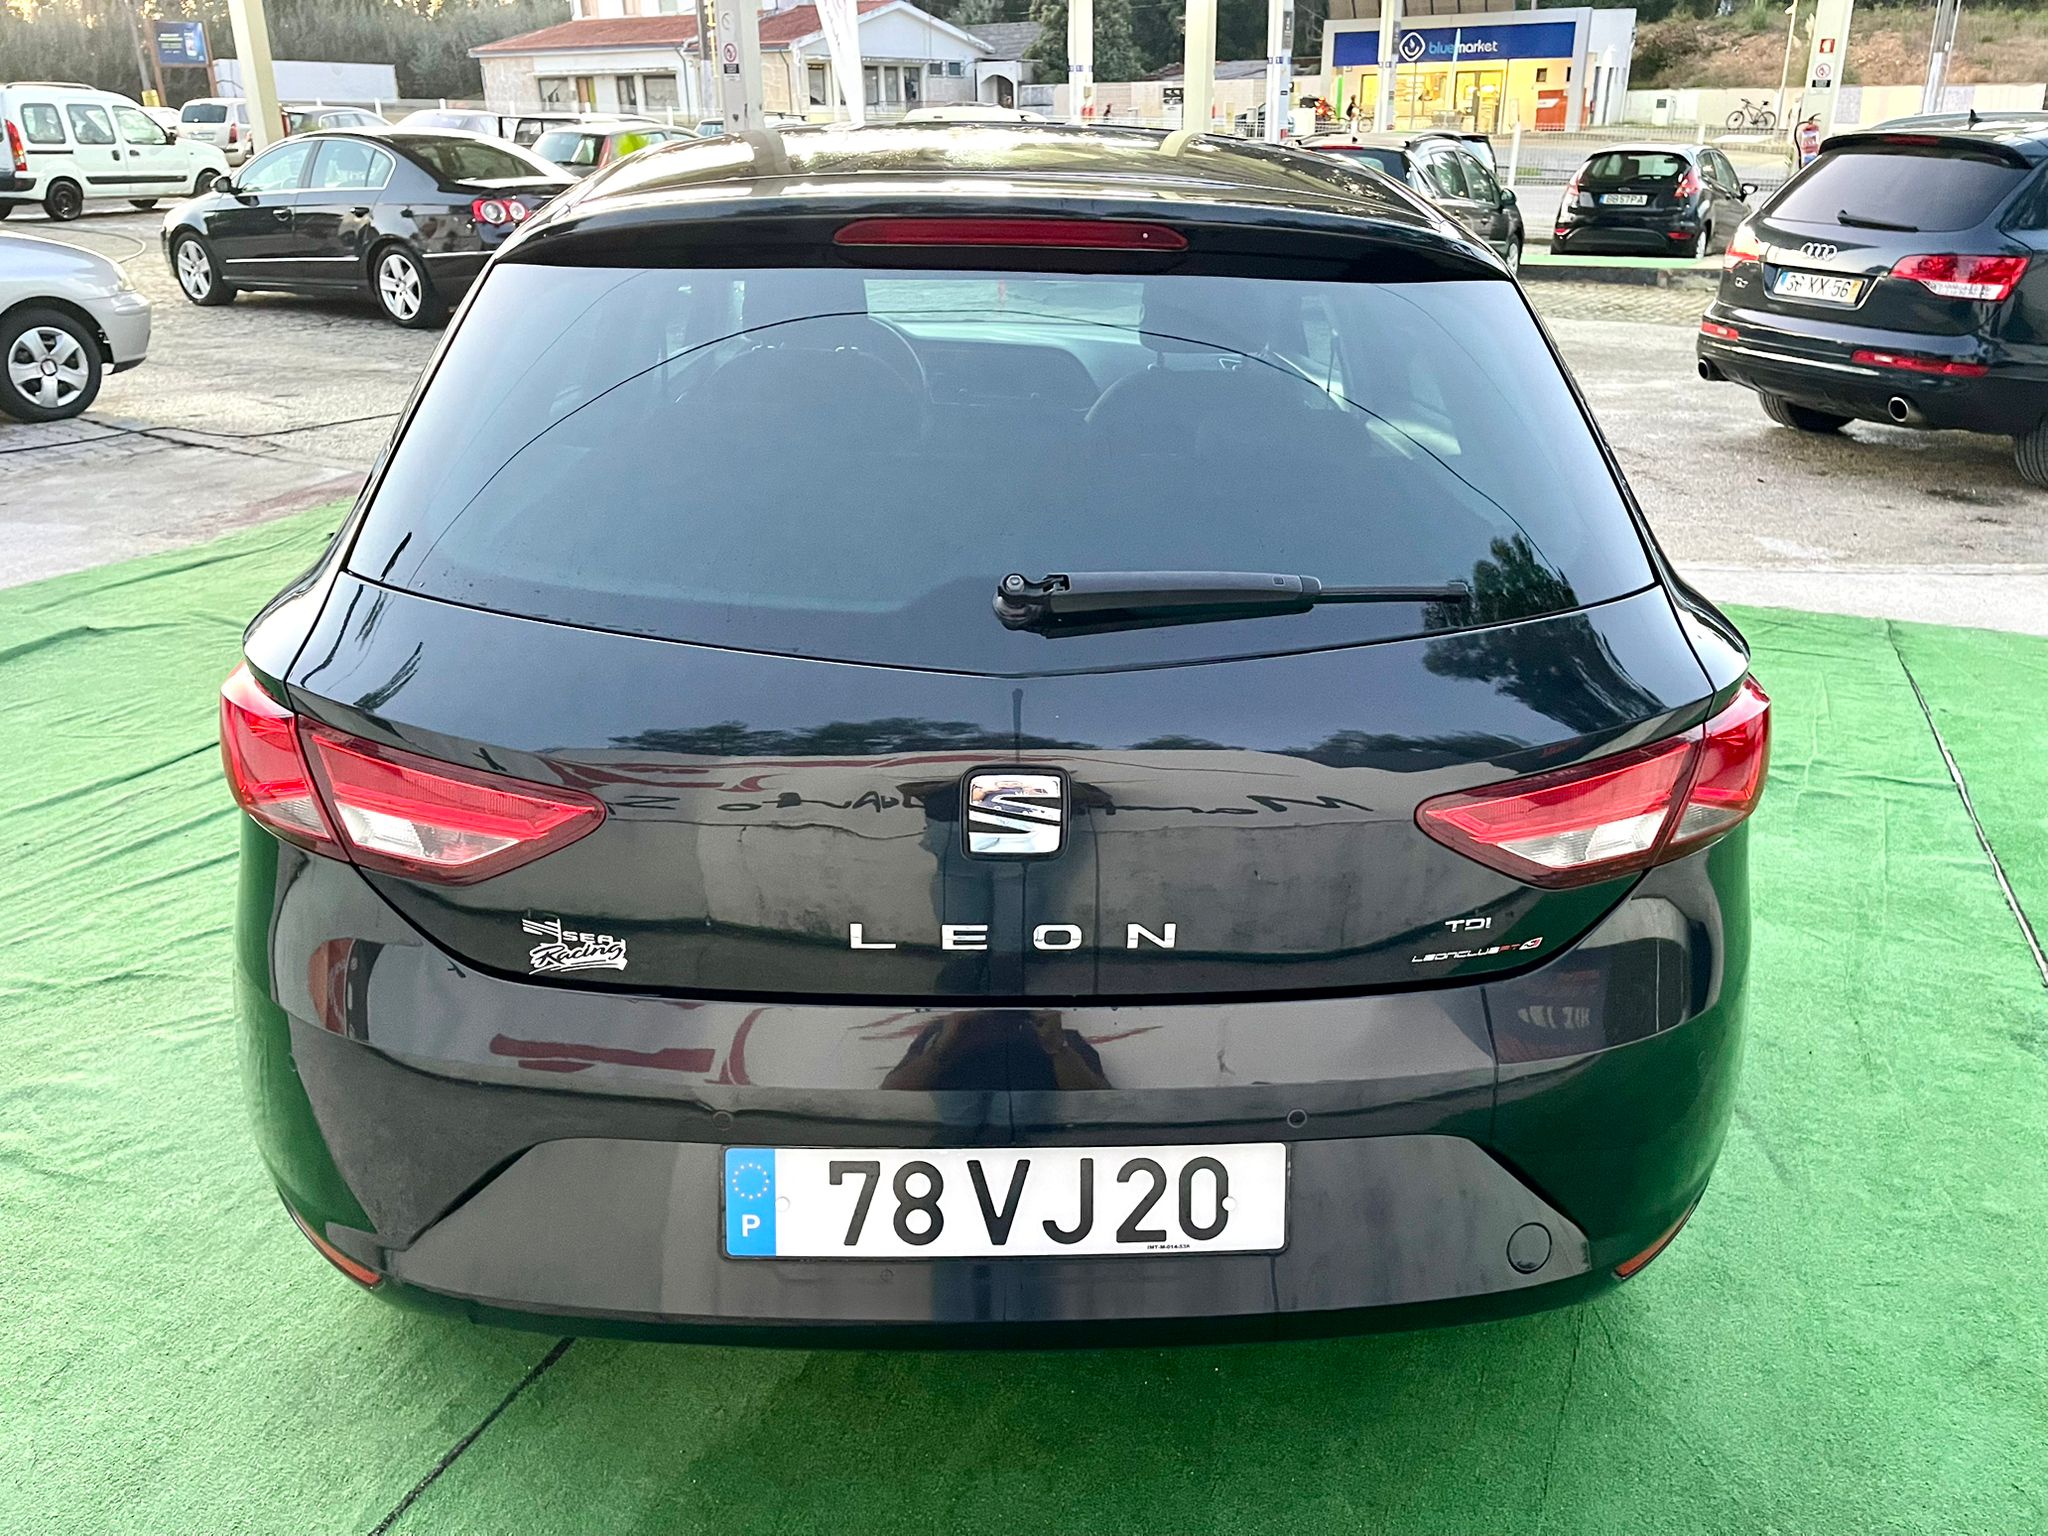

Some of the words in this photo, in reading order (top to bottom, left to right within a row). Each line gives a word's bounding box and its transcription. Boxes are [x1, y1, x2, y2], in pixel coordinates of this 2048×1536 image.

[1444, 917, 1492, 932] TDI
[562, 930, 626, 946] SEA
[849, 923, 1177, 950] LEON
[530, 943, 624, 968] Racing
[741, 1214, 761, 1237] P
